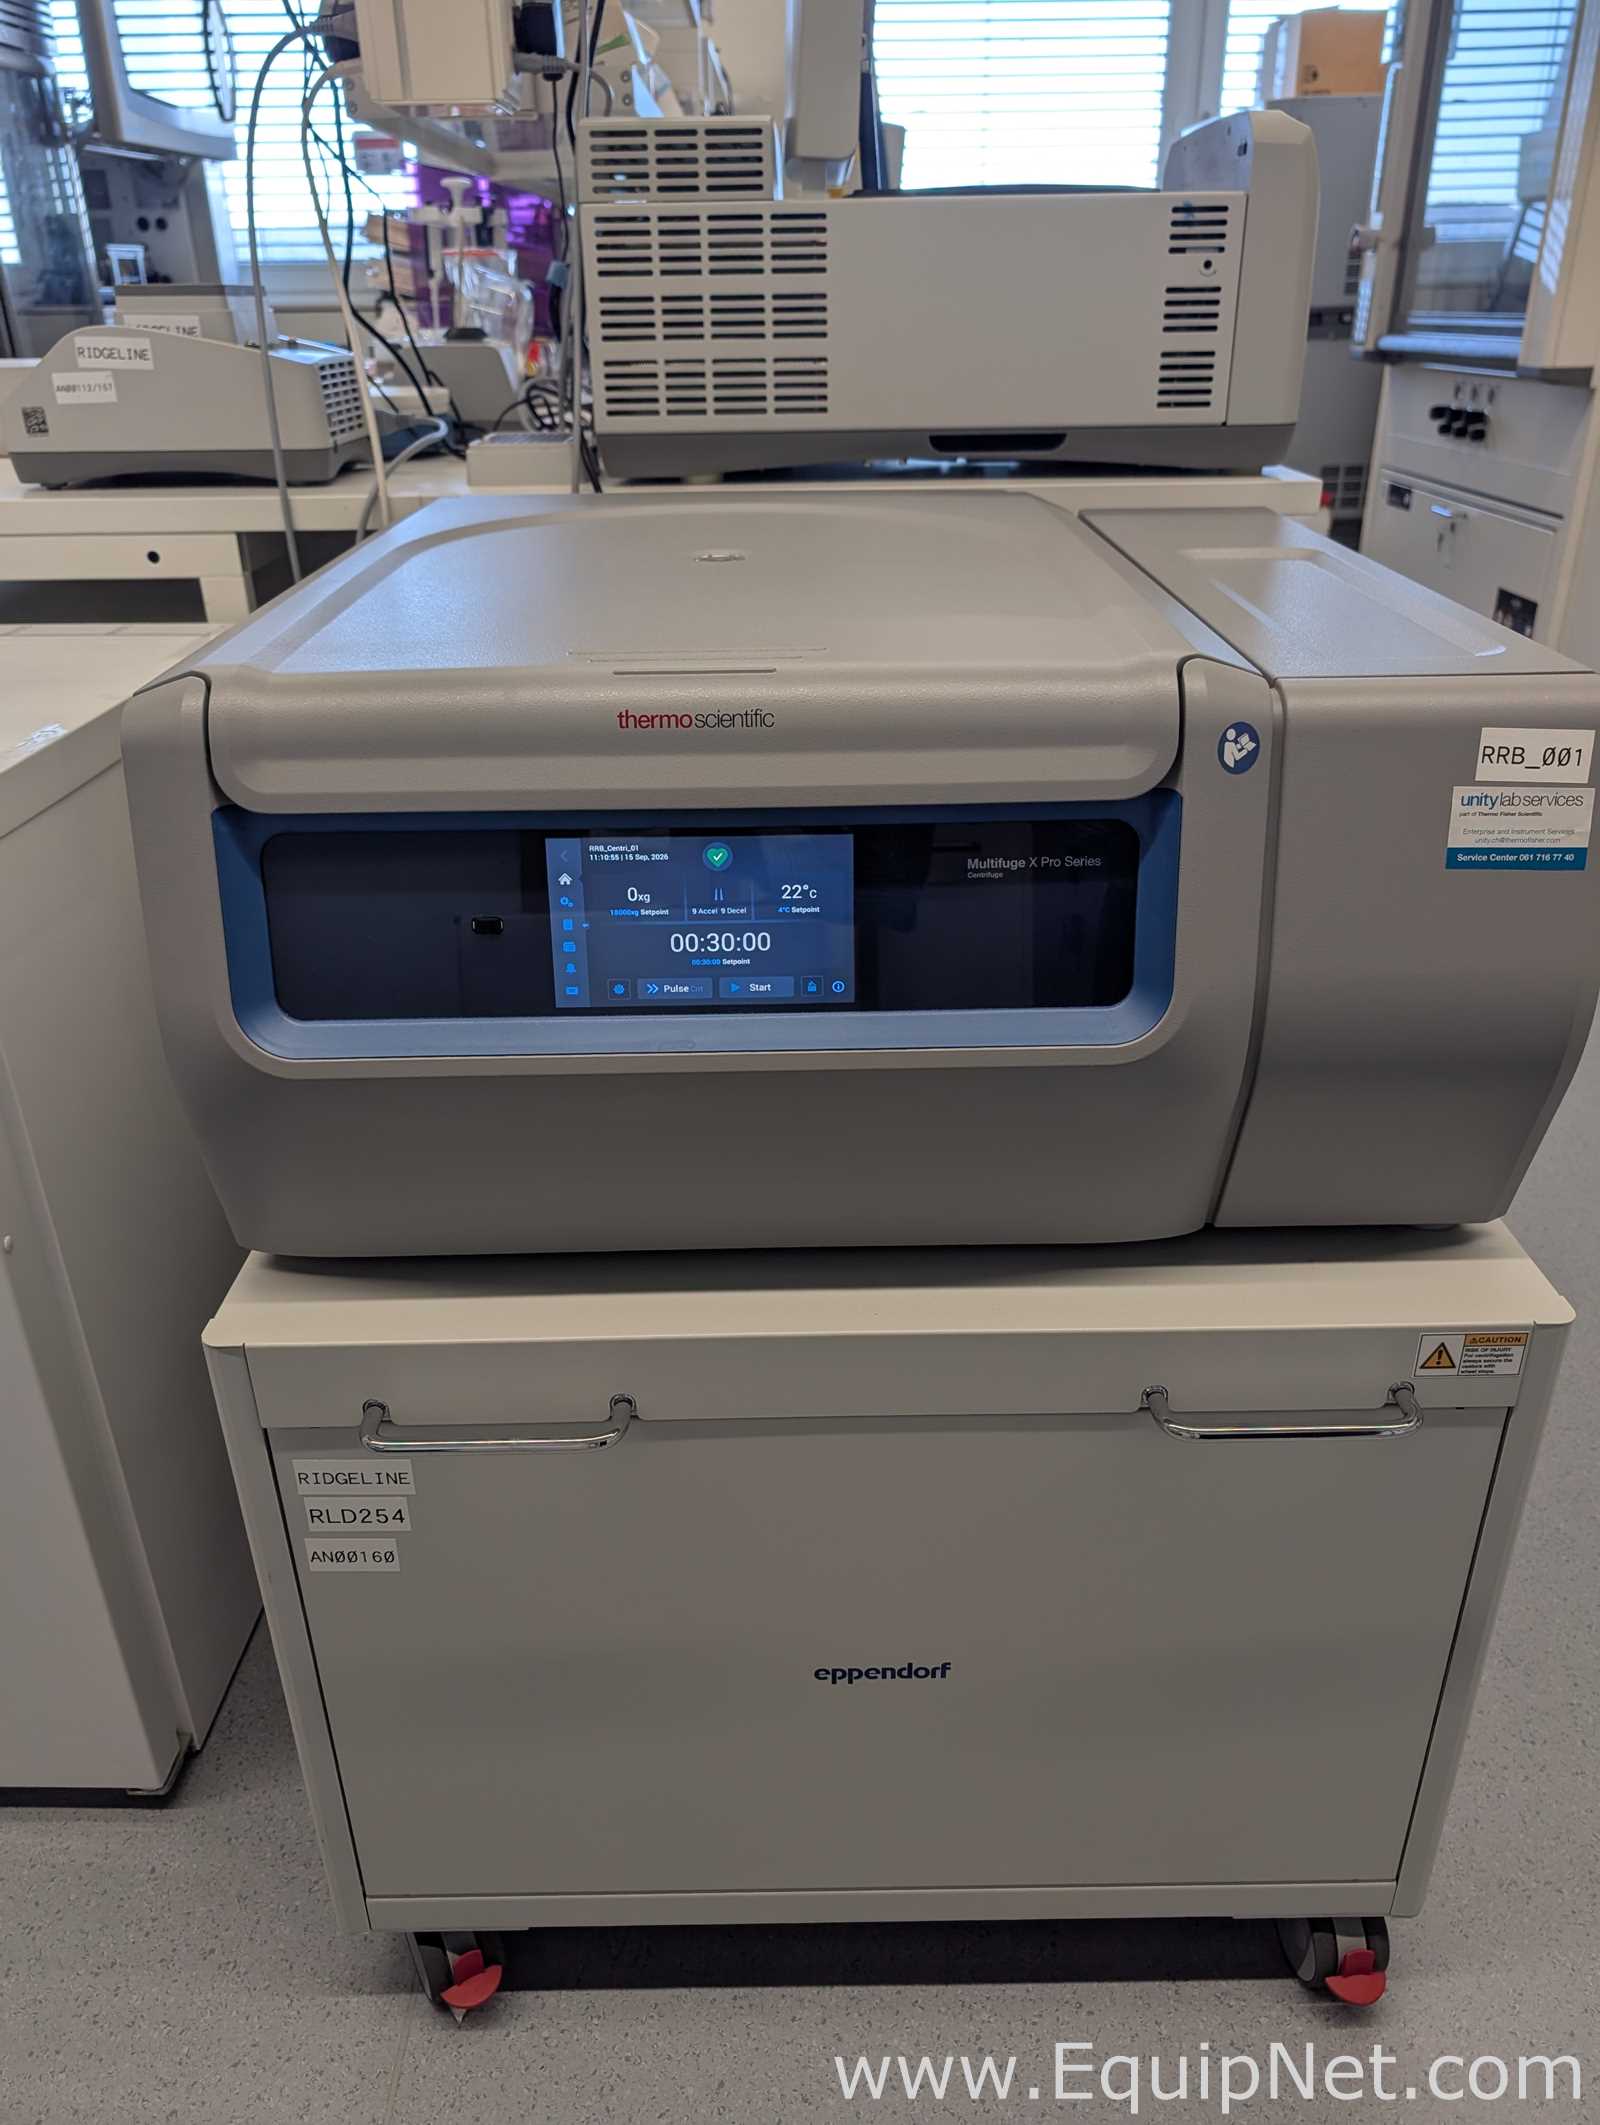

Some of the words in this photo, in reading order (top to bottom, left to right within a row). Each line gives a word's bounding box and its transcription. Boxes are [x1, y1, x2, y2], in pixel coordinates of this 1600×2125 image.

[77, 345, 150, 361] RIDGELINE
[617, 709, 692, 729] thermo
[694, 708, 775, 729] scientific
[1481, 745, 1583, 769] RRB_001
[588, 844, 639, 853] RRB_Centri_01
[967, 857, 1026, 871] Multifuge
[1029, 857, 1038, 868] X
[1041, 856, 1062, 868] Pro
[1064, 855, 1102, 867] Series
[1457, 853, 1489, 862] Service
[1489, 853, 1518, 862] Center
[1552, 853, 1563, 862] 77
[1563, 853, 1575, 862] 40
[967, 871, 1004, 879] Centrifuge
[791, 906, 820, 914] Setpoint
[670, 931, 771, 953] 00:30:00
[722, 957, 750, 966] Setpoint
[663, 984, 689, 993] Pulse
[749, 983, 771, 992] Start
[1478, 1335, 1522, 1344] CAUTION
[298, 1472, 411, 1485] RIDGELINE
[309, 1508, 405, 1524] RLD254
[814, 1662, 951, 1684] eppendorf
